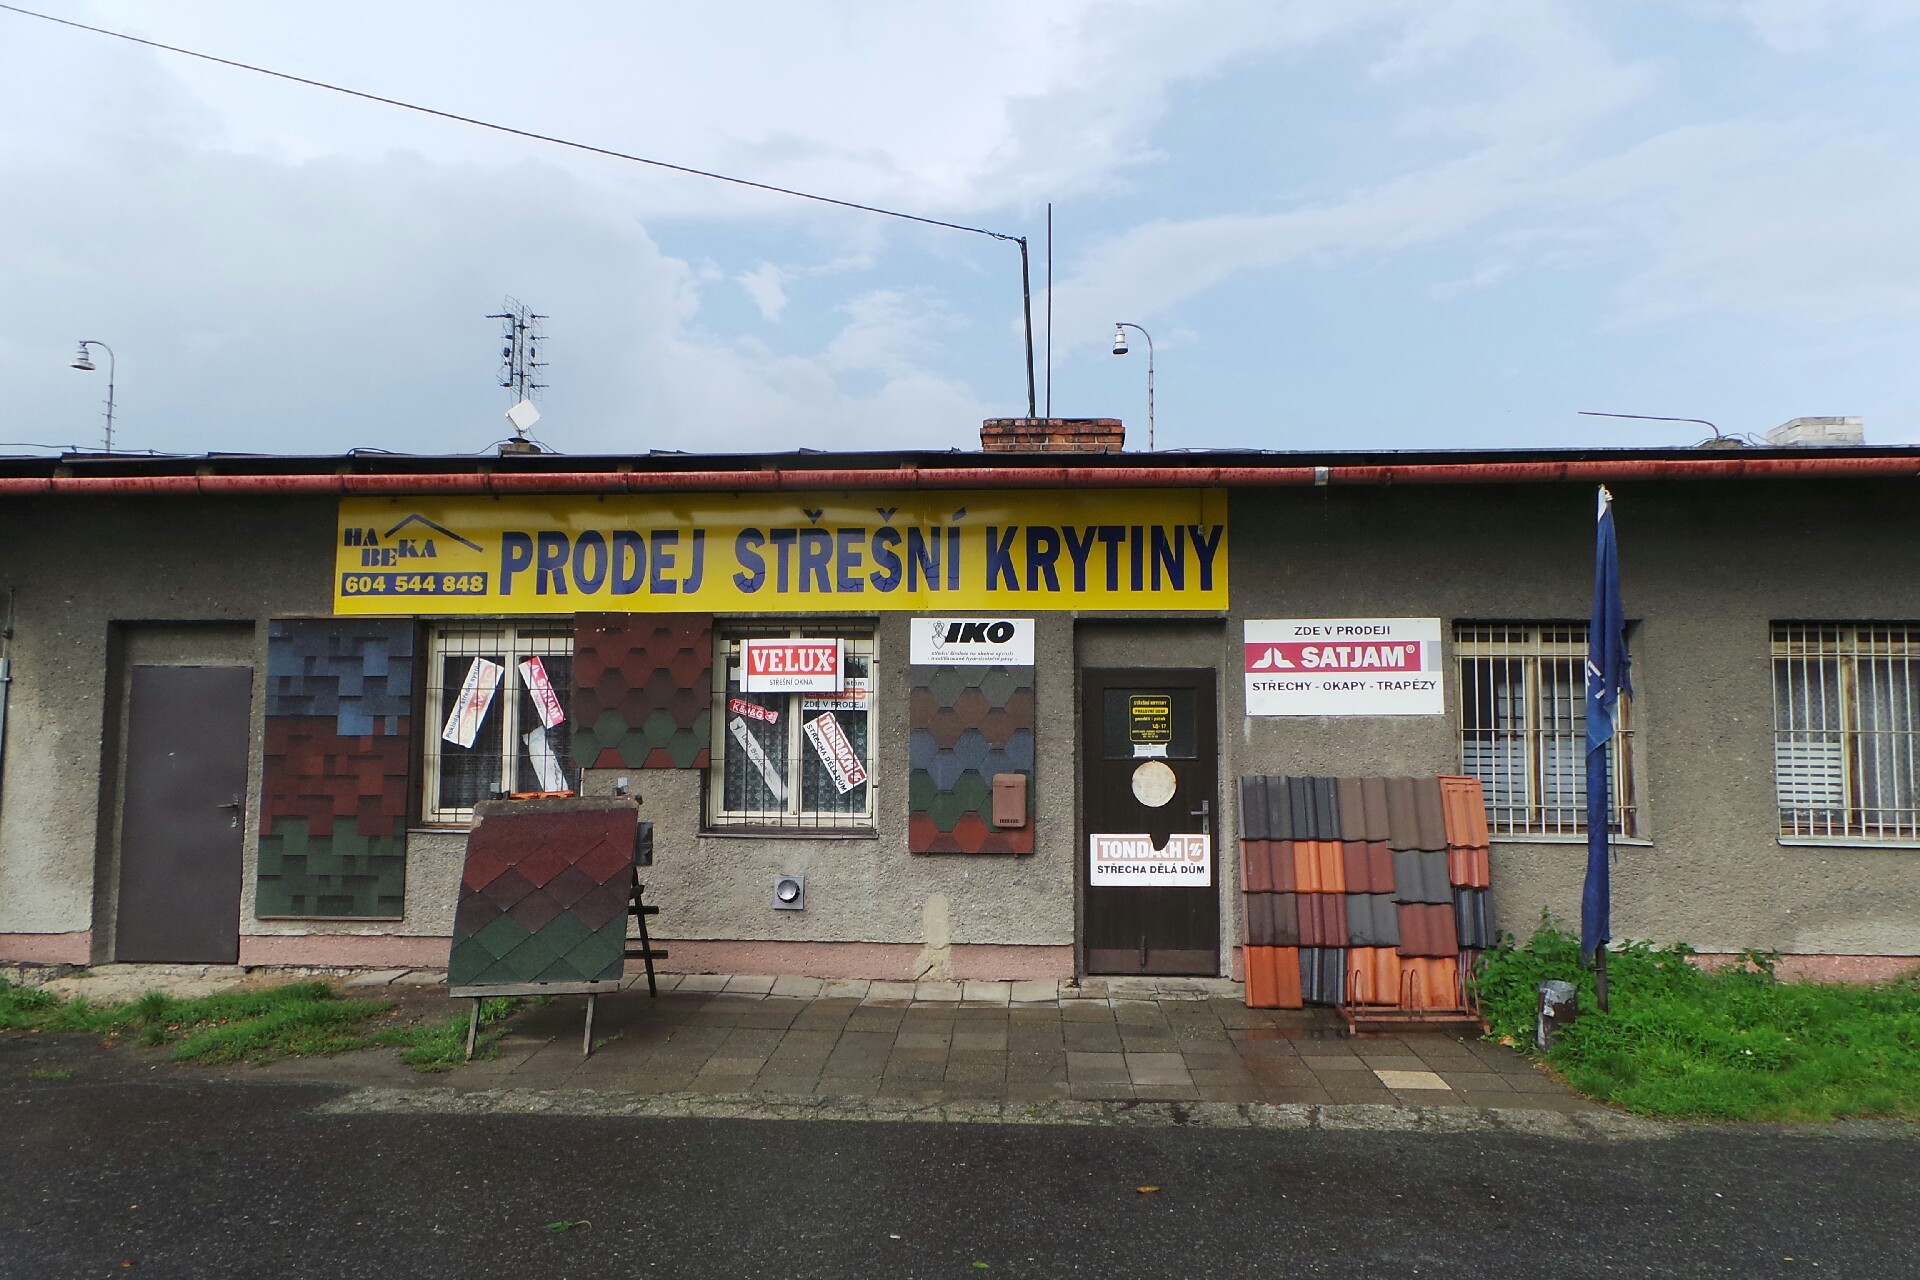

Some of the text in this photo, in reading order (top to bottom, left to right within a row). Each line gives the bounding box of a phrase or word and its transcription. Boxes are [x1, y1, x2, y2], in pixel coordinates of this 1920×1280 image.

[343, 528, 379, 546] HA
[361, 548, 398, 567] BE
[398, 539, 437, 558] KA
[499, 507, 1224, 595] PRODEJ STŘEŠNÍ KRYTINY
[345, 575, 484, 593] 604 544 848
[944, 621, 1015, 643] IKO
[1294, 626, 1391, 636] ZDE V PRODEJI
[769, 677, 793, 686] STŘEŠNÍ
[1252, 679, 1312, 691] STŘECHY
[1323, 681, 1366, 691] OKAPY
[1377, 678, 1437, 690] TRAPÉZY
[1097, 863, 1205, 874] STŘECHA DĚLÁ DŮM
